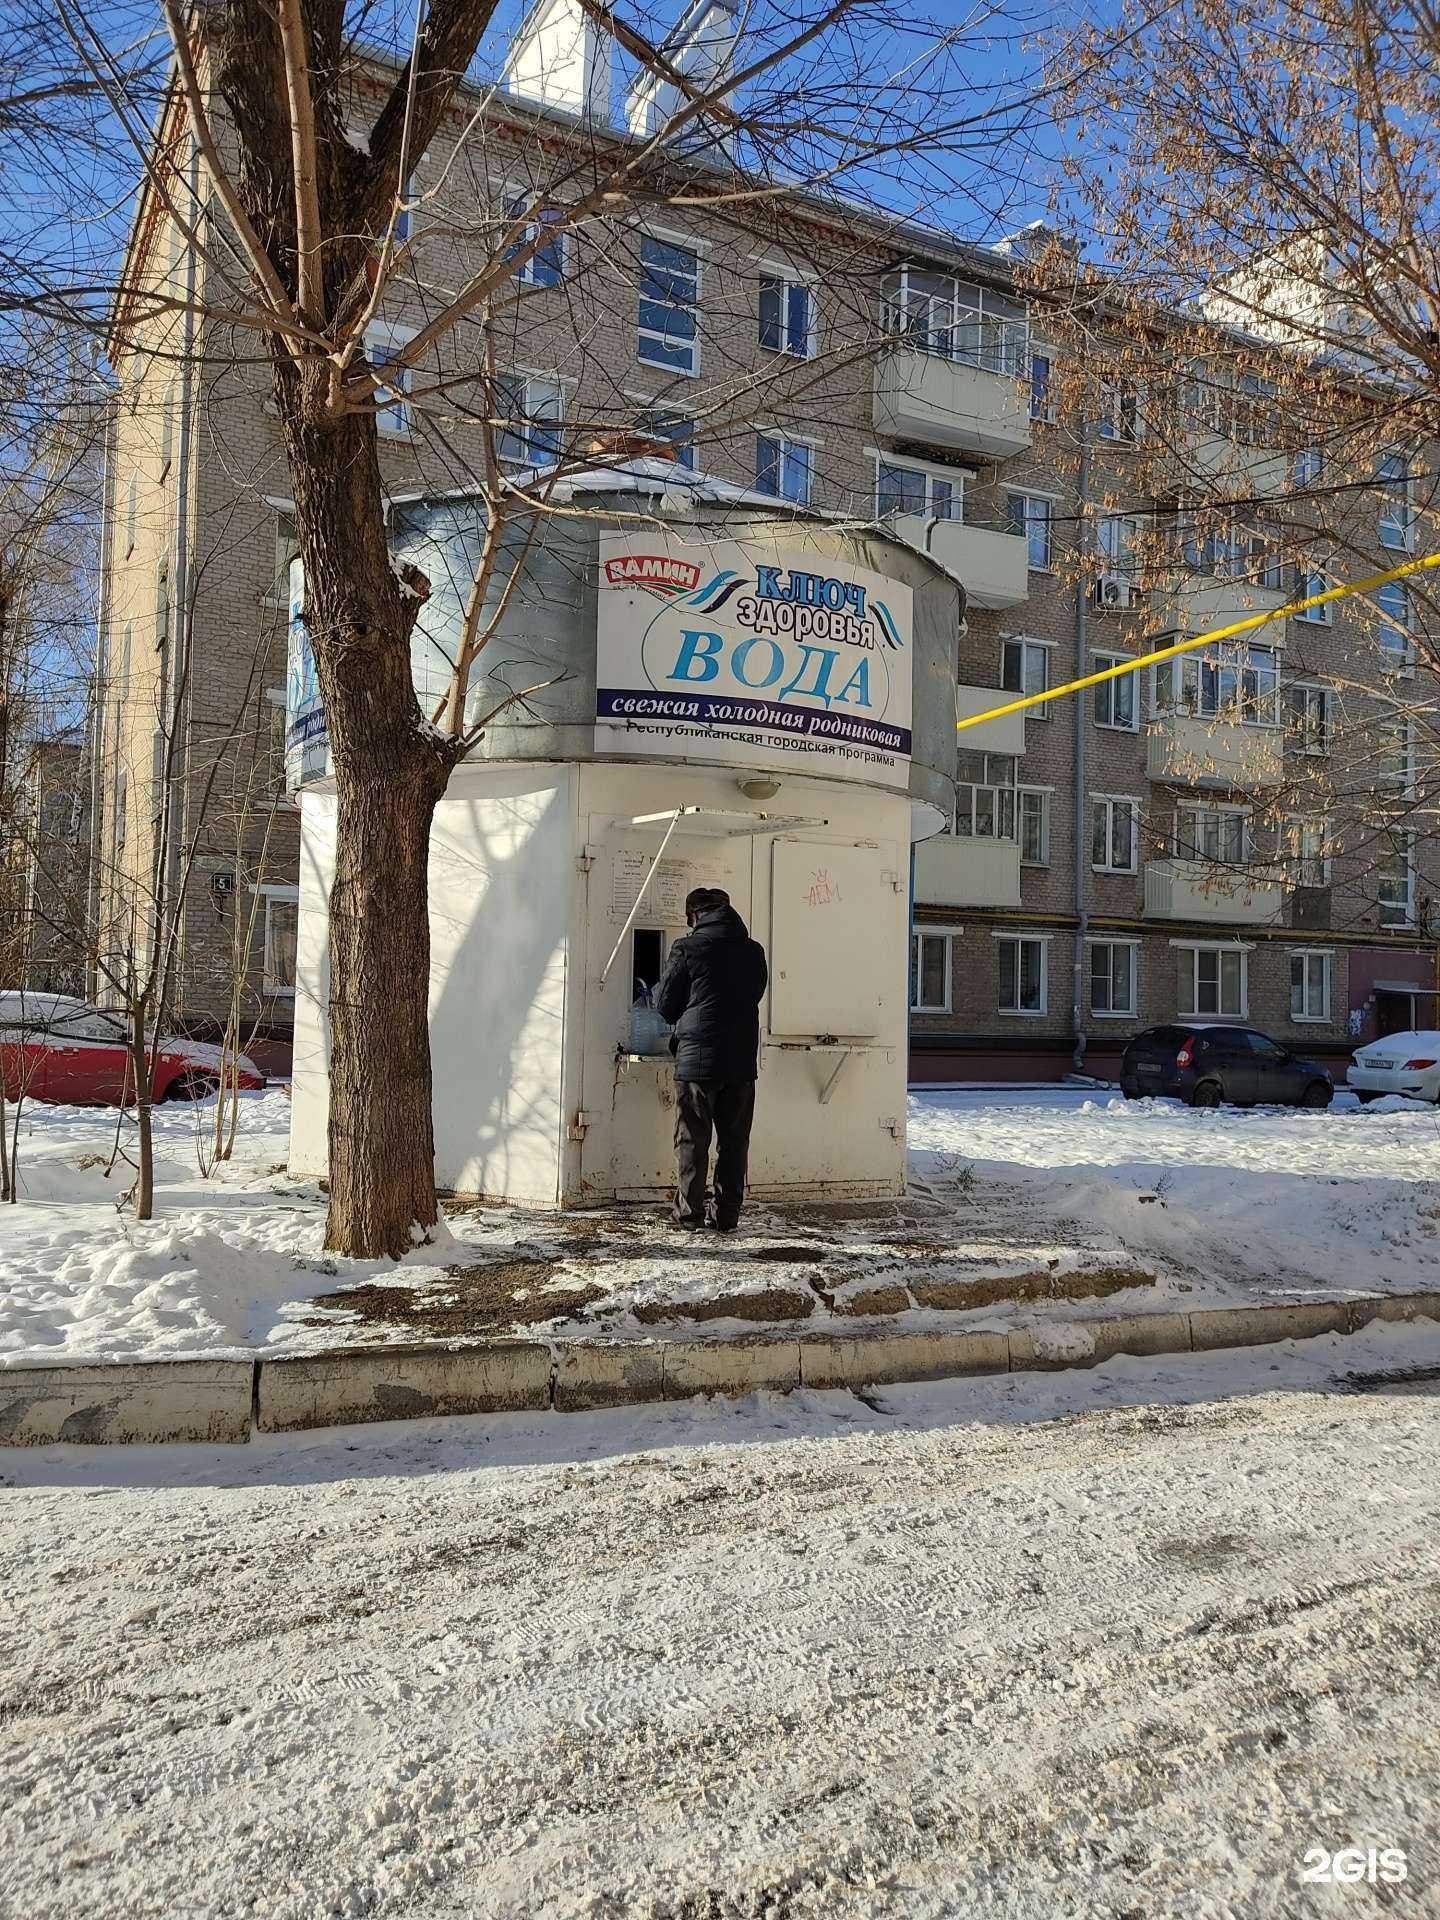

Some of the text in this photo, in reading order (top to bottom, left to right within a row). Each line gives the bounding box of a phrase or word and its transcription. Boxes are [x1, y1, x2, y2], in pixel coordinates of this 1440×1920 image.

[609, 559, 696, 585] ВАМИН
[756, 565, 866, 617] КЛЮЧ
[665, 629, 872, 709] ВОДА
[611, 698, 902, 748] свежая холодная родниковая
[626, 721, 895, 767] Республиканская городская программа
